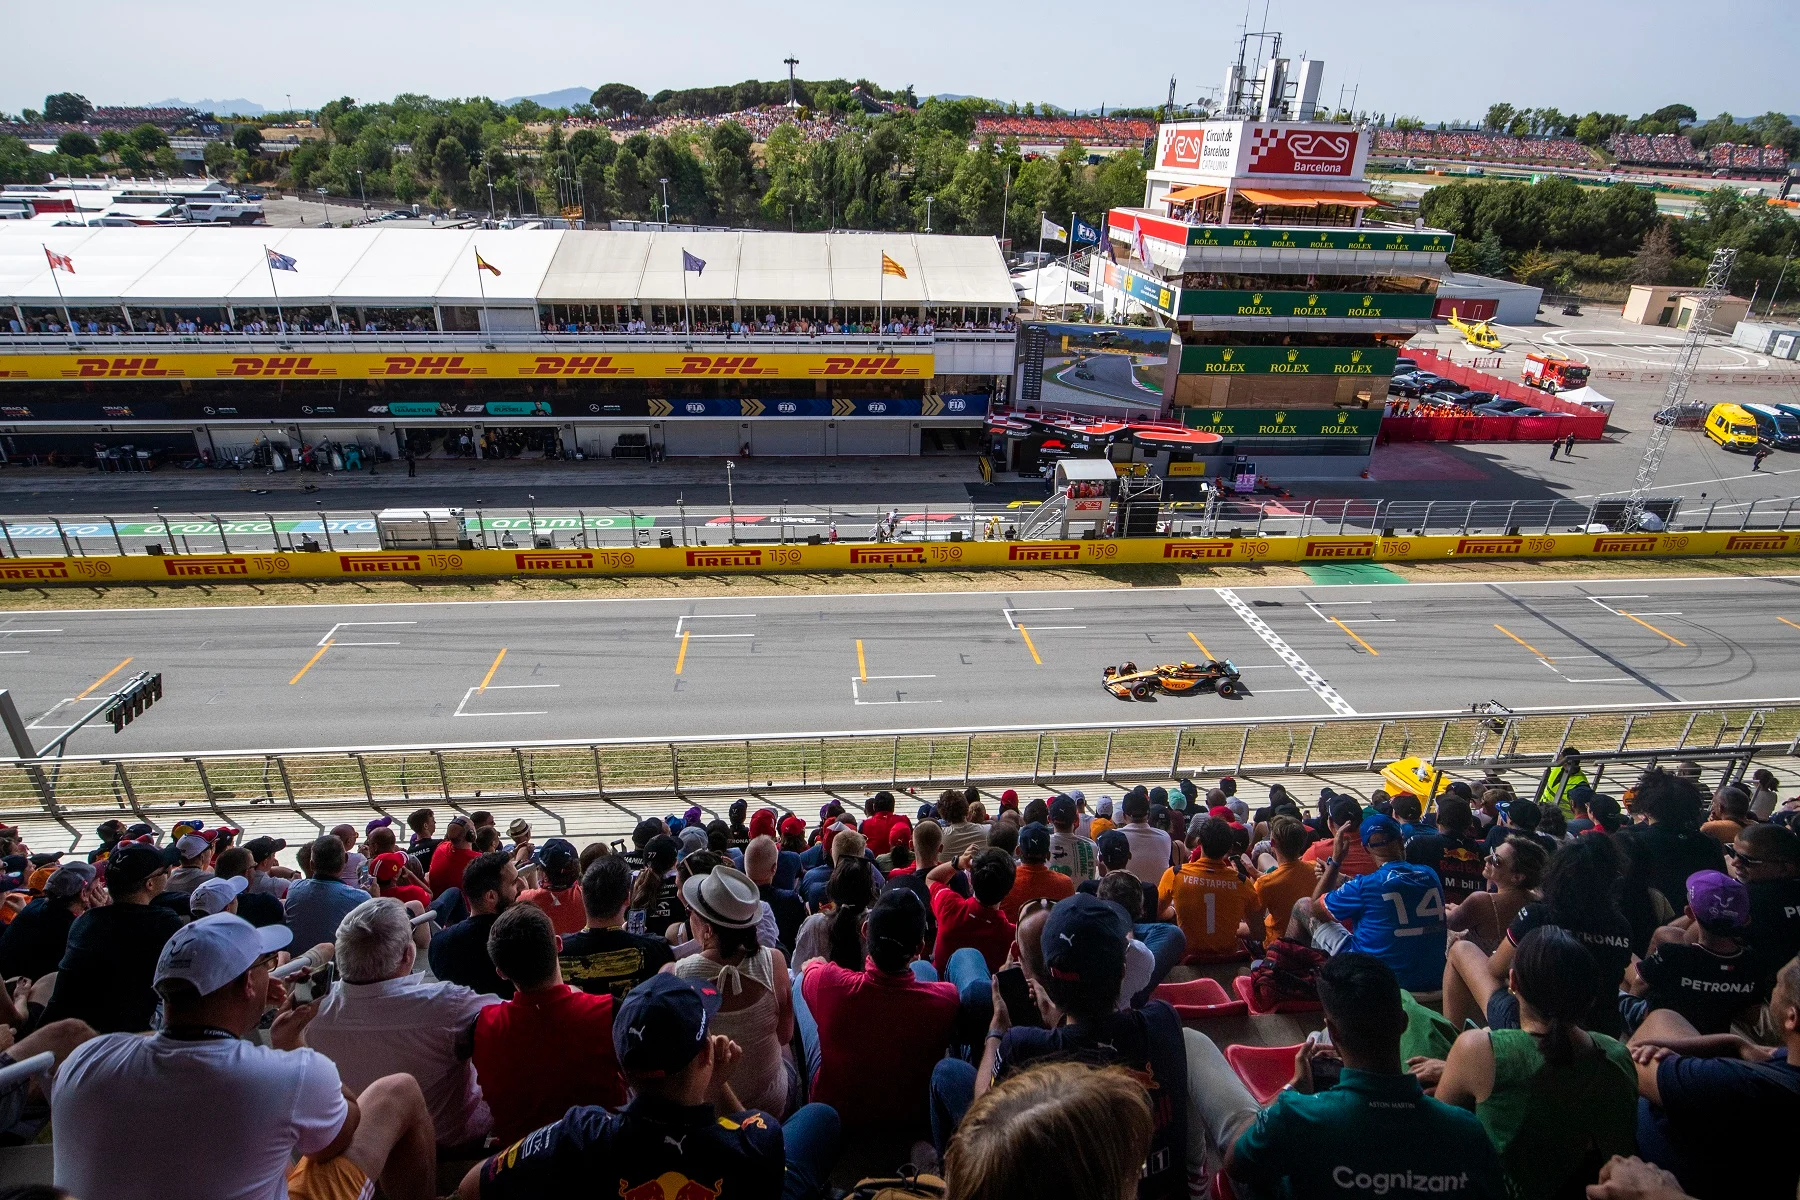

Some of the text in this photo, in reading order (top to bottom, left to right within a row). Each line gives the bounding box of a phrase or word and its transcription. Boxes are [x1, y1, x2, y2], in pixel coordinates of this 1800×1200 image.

[1206, 128, 1233, 142] Circuit de
[1203, 145, 1230, 157] Barcelona
[1293, 161, 1341, 173] Barcelona
[1194, 238, 1218, 246] ROLEX
[1233, 239, 1257, 247] ROLEX
[1271, 240, 1296, 248] ROLEX
[1348, 242, 1372, 250] ROLEX
[1422, 244, 1446, 252] ROLEX
[1238, 306, 1273, 315] ROLEX
[1293, 307, 1327, 316] ROLEX
[1347, 308, 1382, 317] ROLEX
[77, 358, 168, 377] DHL
[232, 357, 320, 376] DHL
[385, 356, 472, 375] DHL
[534, 356, 620, 375] DHL
[680, 356, 765, 375] DHL
[823, 357, 905, 375] DHL
[1205, 363, 1245, 372] ROLEX
[1270, 363, 1309, 373] ROLEX
[1333, 364, 1373, 374] ROLEX
[685, 402, 706, 414] FIA
[778, 402, 797, 414] FIA
[867, 402, 887, 414] FIA
[948, 398, 966, 412] FIA
[1196, 425, 1235, 434] ROLEX
[1258, 425, 1297, 434] ROLEX
[1321, 425, 1358, 434] ROLEX
[144, 521, 273, 534] aramco
[491, 516, 616, 529] aramco
[1305, 540, 1412, 557] PIRELLI 150
[1456, 537, 1556, 554] PIRELLI 150
[1592, 535, 1689, 553] PIRELLI 150
[1726, 535, 1789, 550] PIRELLI
[850, 546, 963, 564] PIRELLI 150
[1009, 543, 1118, 560] PIRELLI 150
[1164, 541, 1270, 558] PIRELLI 150
[339, 553, 463, 572] PIRELLI 150
[515, 552, 635, 570] PIRELLI 150
[686, 549, 802, 566] PIRELLI 150
[73, 560, 112, 578] 150
[164, 557, 290, 576] PIRELLI 150
[647, 851, 657, 859] 77
[1183, 874, 1238, 891] VERSTAPPEN
[1445, 877, 1474, 890] Mbil
[1381, 886, 1444, 925] 14
[1203, 892, 1216, 935] 1
[1369, 1100, 1416, 1110] ASTON MARTIN
[1332, 1165, 1469, 1195] Cognizant
